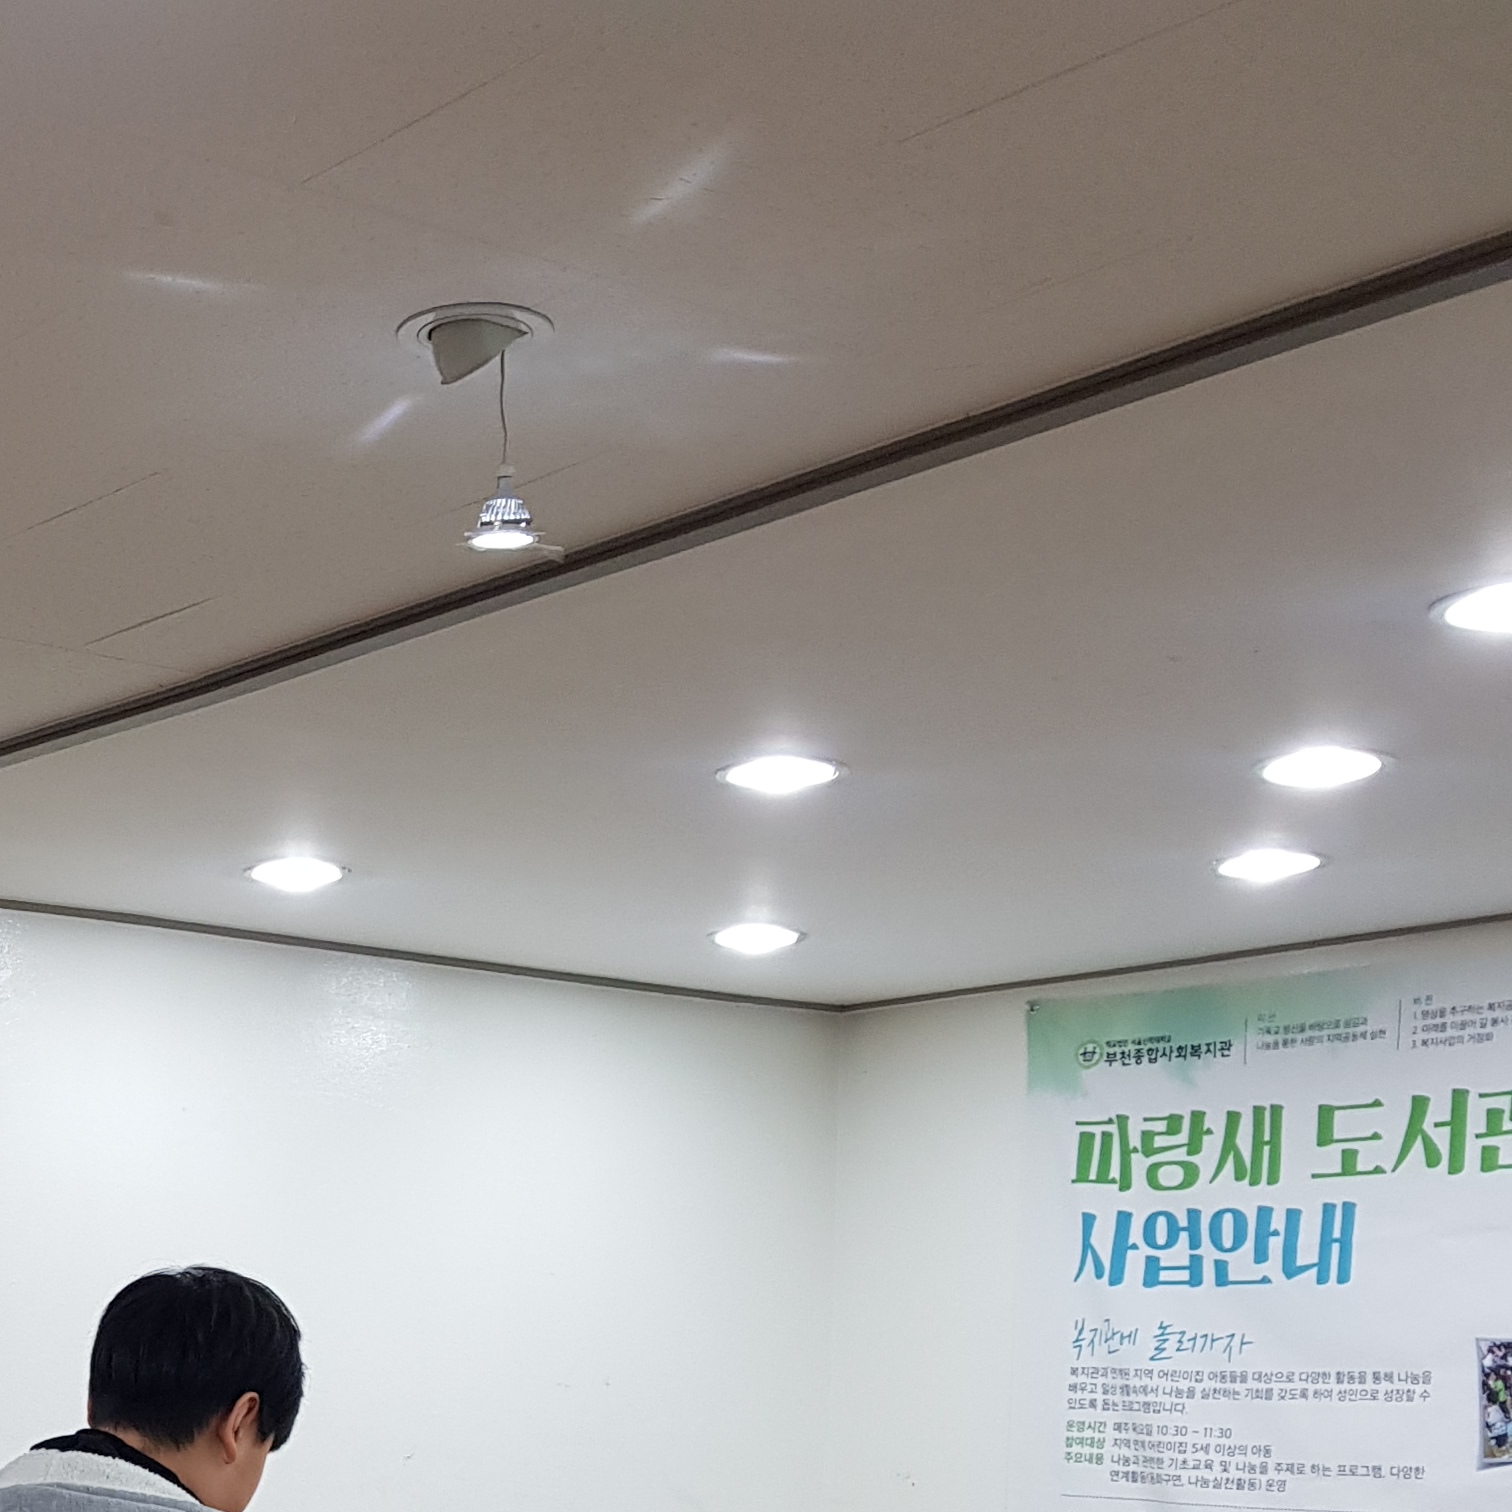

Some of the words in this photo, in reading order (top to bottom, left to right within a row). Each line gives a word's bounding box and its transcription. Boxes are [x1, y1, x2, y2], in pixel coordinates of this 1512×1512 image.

[1104, 1040, 1233, 1066] 부천종합사회복지관
[1070, 1103, 1285, 1192] 파랑새
[1074, 1201, 1357, 1288] 사업안내
[1072, 1318, 1139, 1361] 복지관에
[1149, 1320, 1254, 1363] 놀러가자
[1133, 1368, 1154, 1381] 지역
[1157, 1369, 1204, 1383] 어린이집
[1207, 1370, 1248, 1384] 아동들을
[1252, 1370, 1295, 1384] 대상으로
[1299, 1371, 1331, 1384] 다양한
[1336, 1371, 1367, 1384] 활동을
[1372, 1371, 1394, 1385] 통해
[1397, 1371, 1432, 1385] 나눔을
[1068, 1382, 1098, 1394] 배우고
[1162, 1384, 1196, 1399] 나눔을
[1200, 1386, 1241, 1400] 실천하는
[1245, 1388, 1273, 1400] 기회를
[1277, 1388, 1309, 1401] 갖도록
[1313, 1388, 1333, 1401] 하여
[1337, 1388, 1380, 1402] 성인으로
[1383, 1389, 1416, 1403] 성장할
[1419, 1389, 1431, 1402] 수
[1067, 1398, 1097, 1411] 있도록
[1066, 1420, 1107, 1433] 운영시간
[1156, 1425, 1188, 1437] 10:30
[1203, 1426, 1232, 1439] 11:30
[1065, 1436, 1106, 1449] 참여대상
[1112, 1438, 1131, 1450] 지역
[1191, 1443, 1210, 1455] 5세
[1214, 1444, 1248, 1457] 이상의
[1251, 1444, 1272, 1458] 아동
[1064, 1452, 1105, 1465] 주요내용
[1168, 1458, 1214, 1472] 기초교육
[1219, 1460, 1231, 1473] 및
[1236, 1461, 1268, 1475] 나눔을
[1274, 1462, 1306, 1475] 주제로
[1310, 1463, 1332, 1477] 하는
[1390, 1465, 1425, 1480] 다양한
[1265, 1479, 1286, 1492] 운영
